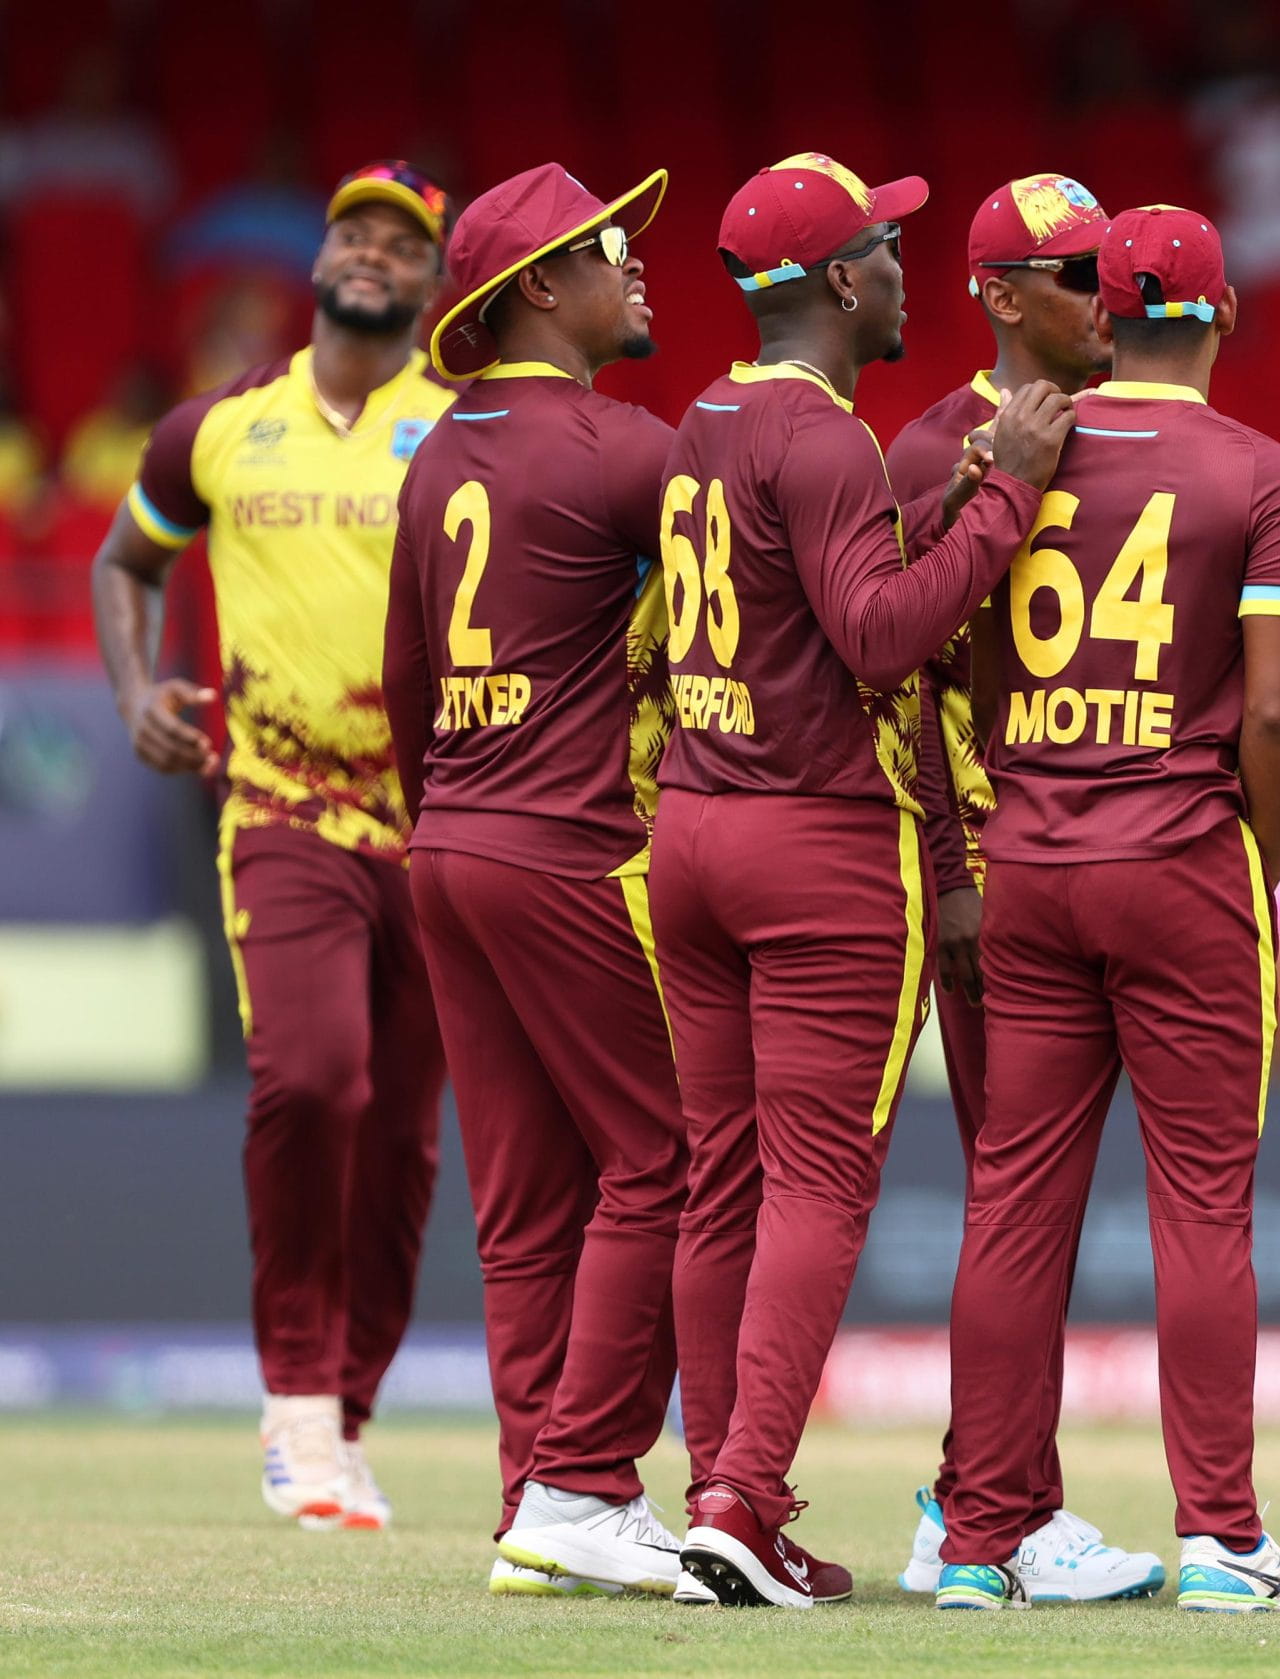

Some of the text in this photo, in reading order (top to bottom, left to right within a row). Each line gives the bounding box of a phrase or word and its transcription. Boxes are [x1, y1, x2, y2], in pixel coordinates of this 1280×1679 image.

[337, 491, 399, 528] IND
[660, 475, 740, 668] 68
[443, 480, 492, 666] 2
[1010, 490, 1176, 681] 64
[670, 674, 755, 736] HERFORD
[1005, 687, 1174, 748] MOTIE
